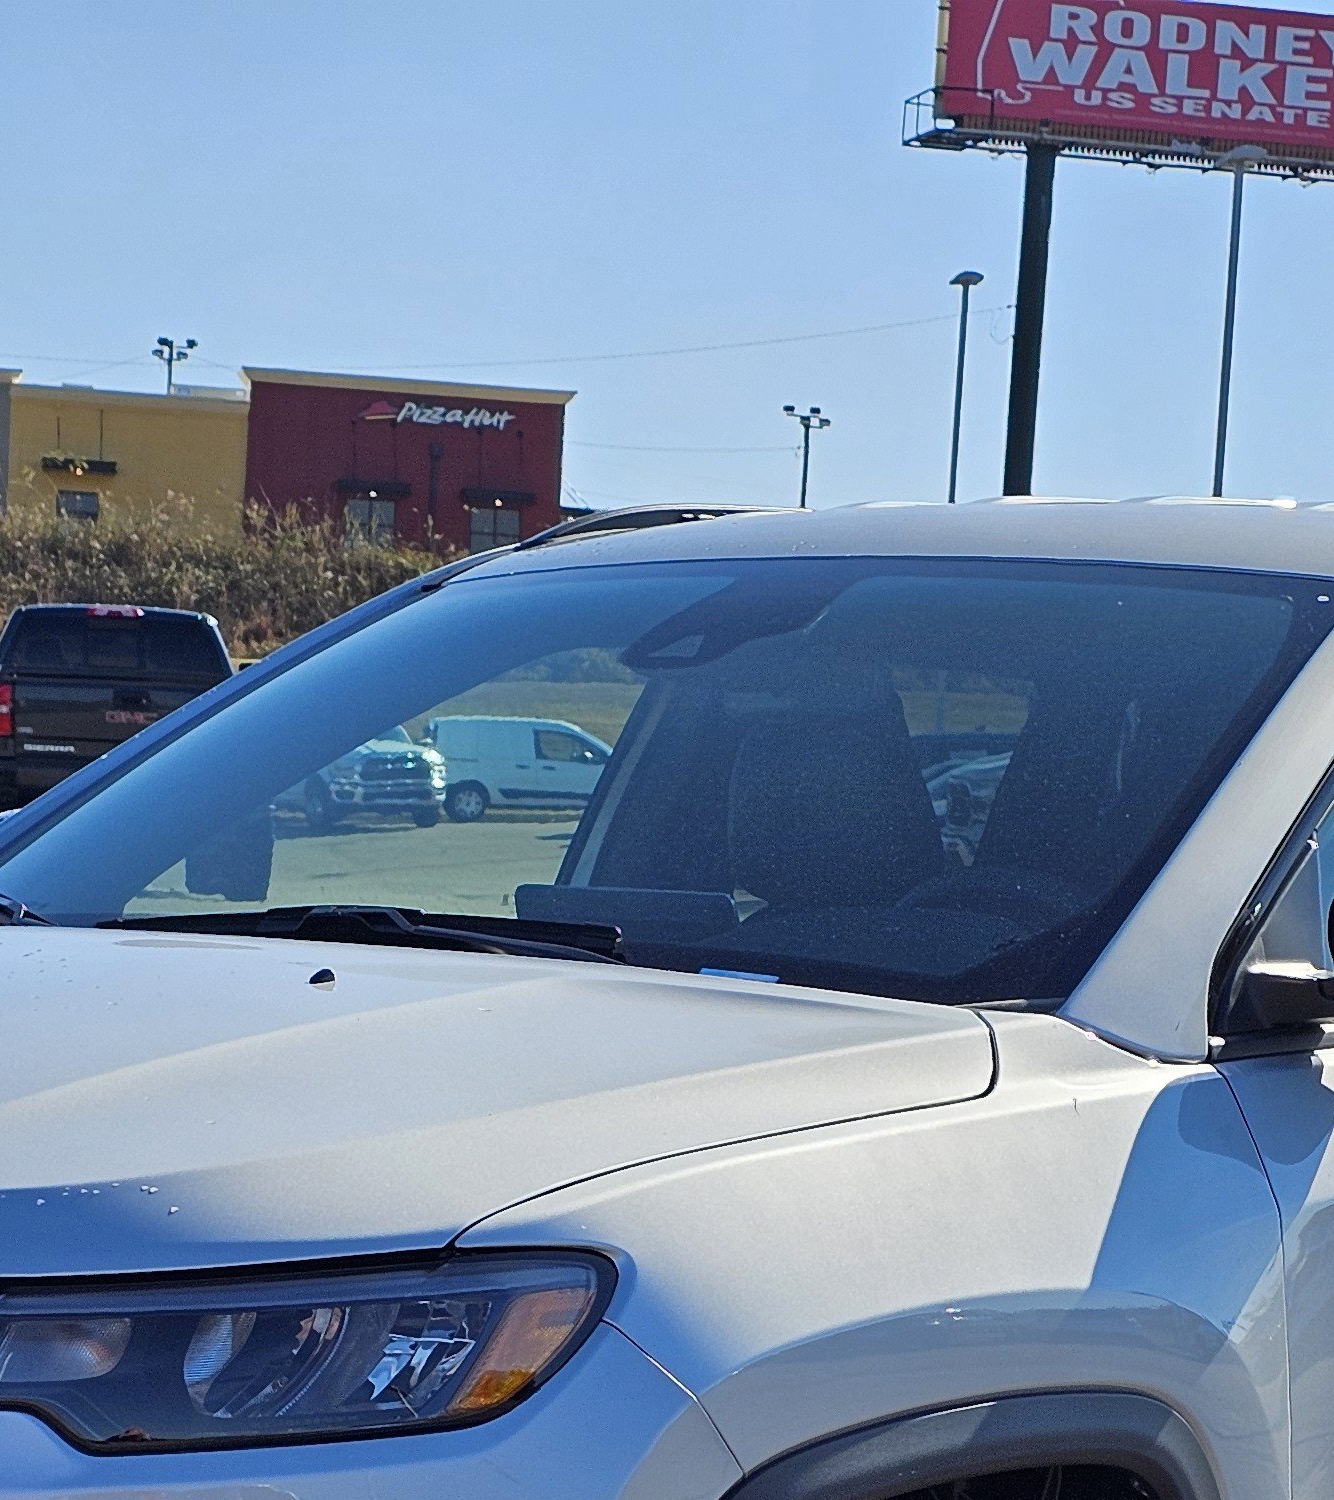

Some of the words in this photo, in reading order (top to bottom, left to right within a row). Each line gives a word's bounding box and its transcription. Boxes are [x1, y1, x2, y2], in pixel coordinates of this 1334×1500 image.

[1072, 88, 1137, 110] US
[1149, 96, 1332, 129] SENATE
[396, 402, 463, 424] Pizza
[463, 407, 516, 430] Hut
